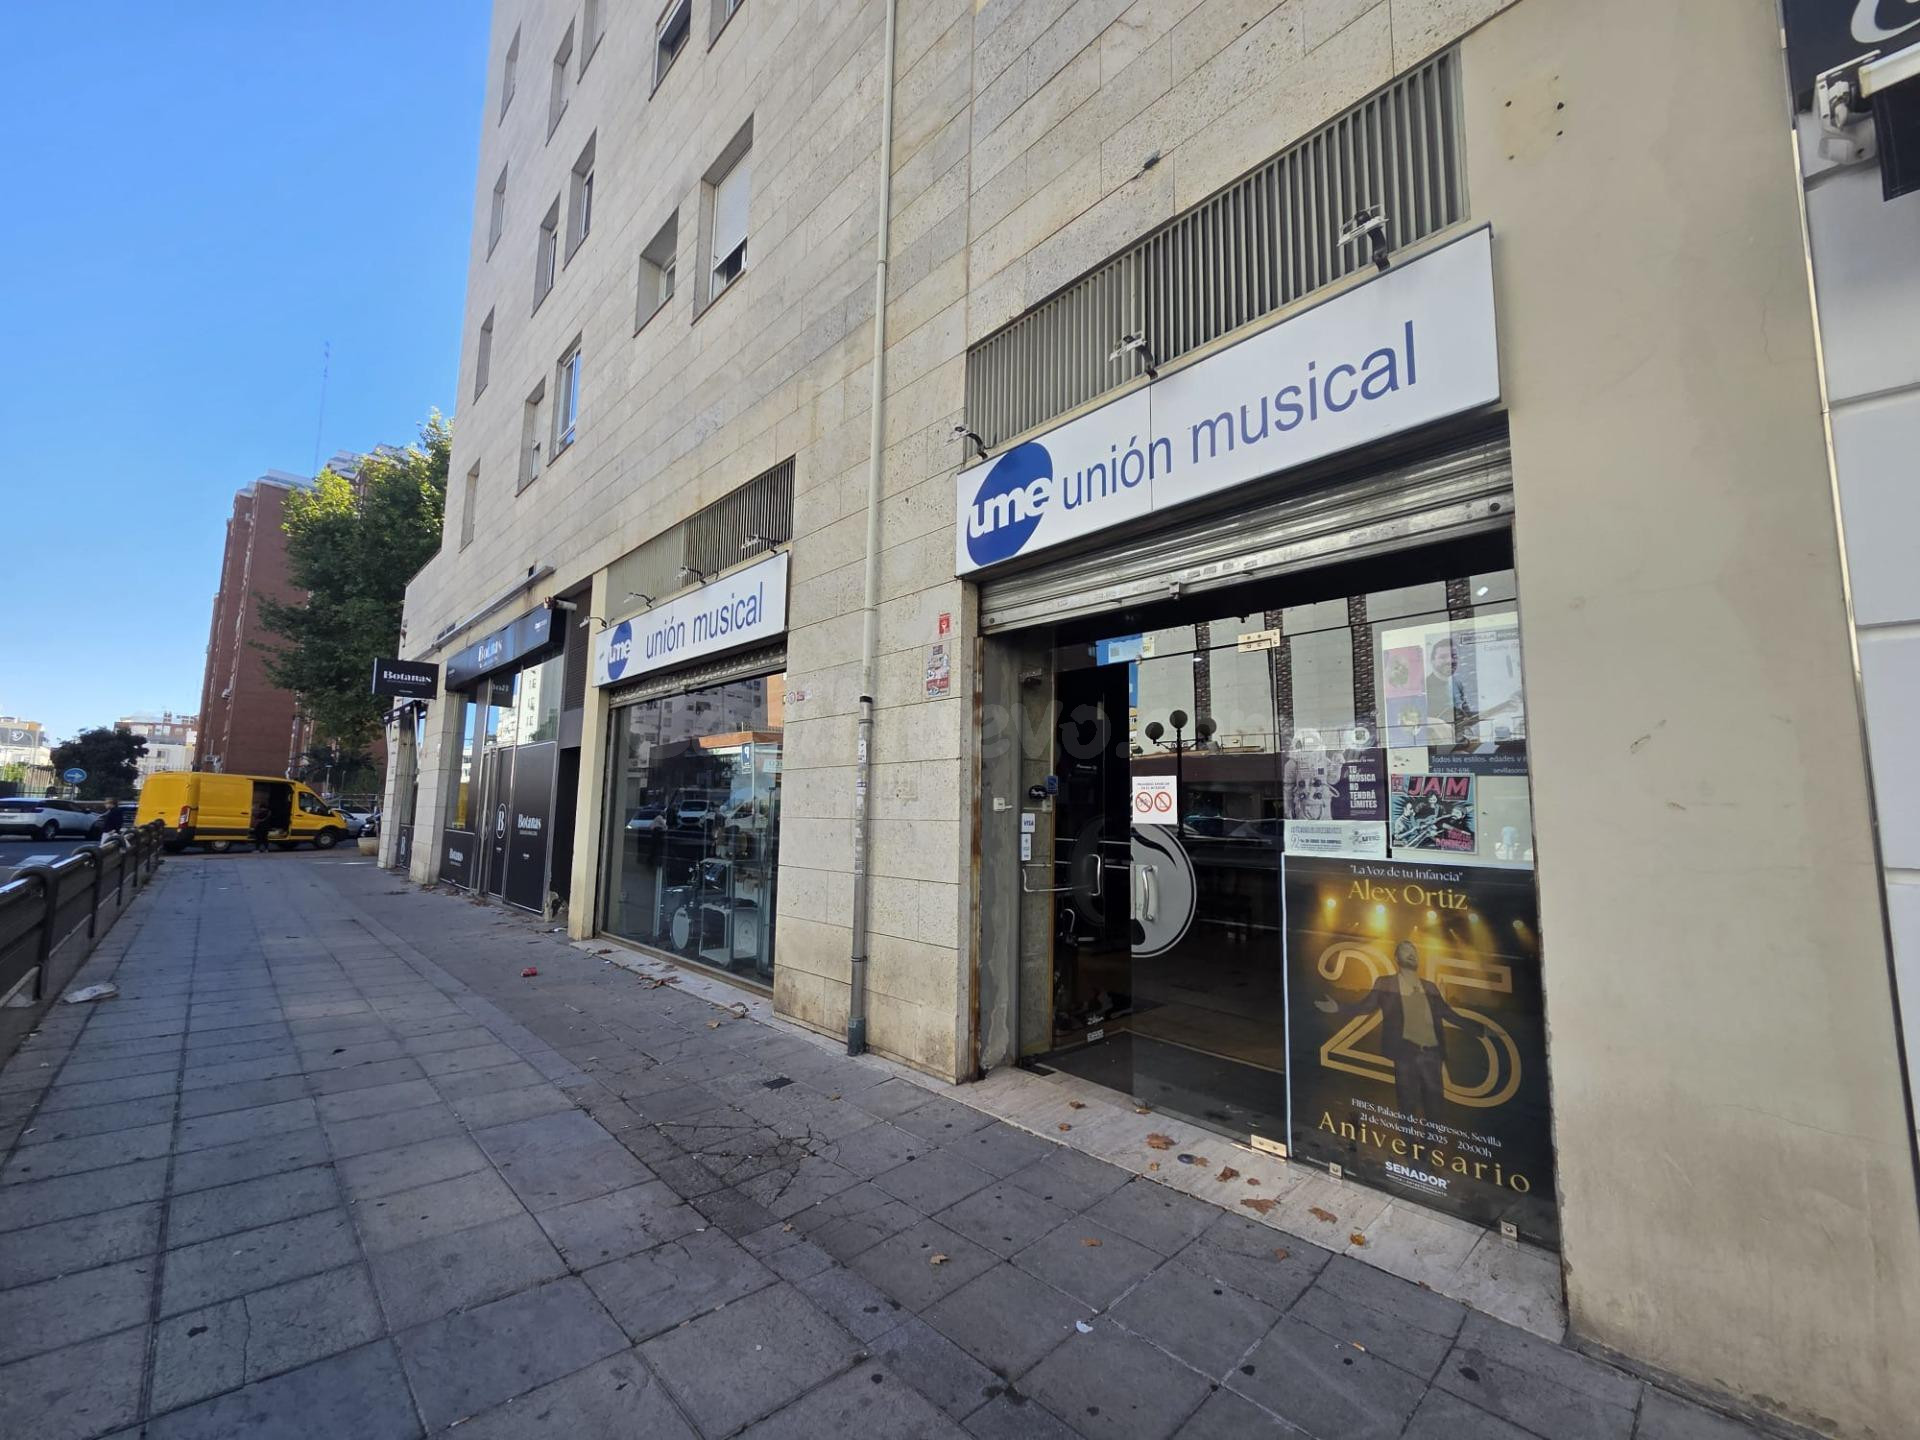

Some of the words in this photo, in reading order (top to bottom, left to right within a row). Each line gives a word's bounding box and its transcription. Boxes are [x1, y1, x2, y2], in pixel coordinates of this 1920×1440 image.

[970, 477, 1053, 538] ume
[1063, 436, 1172, 510] unión
[1192, 320, 1418, 464] musical
[646, 616, 685, 660] unión
[693, 581, 763, 644] musical
[383, 671, 432, 683] Botanas
[1349, 766, 1357, 774] TU
[1407, 777, 1469, 796] JAM
[517, 813, 542, 830] Botanas
[1367, 866, 1386, 876] Voz
[1386, 867, 1401, 878] de
[1402, 870, 1414, 878] tu
[1348, 879, 1398, 904] Alex
[1403, 884, 1468, 910] Ortiz
[1360, 1112, 1368, 1121] 21
[1368, 1114, 1379, 1125] de
[1380, 1118, 1426, 1138] Noviembre
[1427, 1132, 1448, 1145] 2025
[1457, 1141, 1492, 1158] 20:00h
[1377, 1106, 1406, 1121] Palacio
[1407, 1114, 1419, 1125] de
[1471, 1132, 1502, 1147] Sevilla
[1318, 1111, 1531, 1194] Aniversario
[1384, 1160, 1449, 1190] SENADOR
